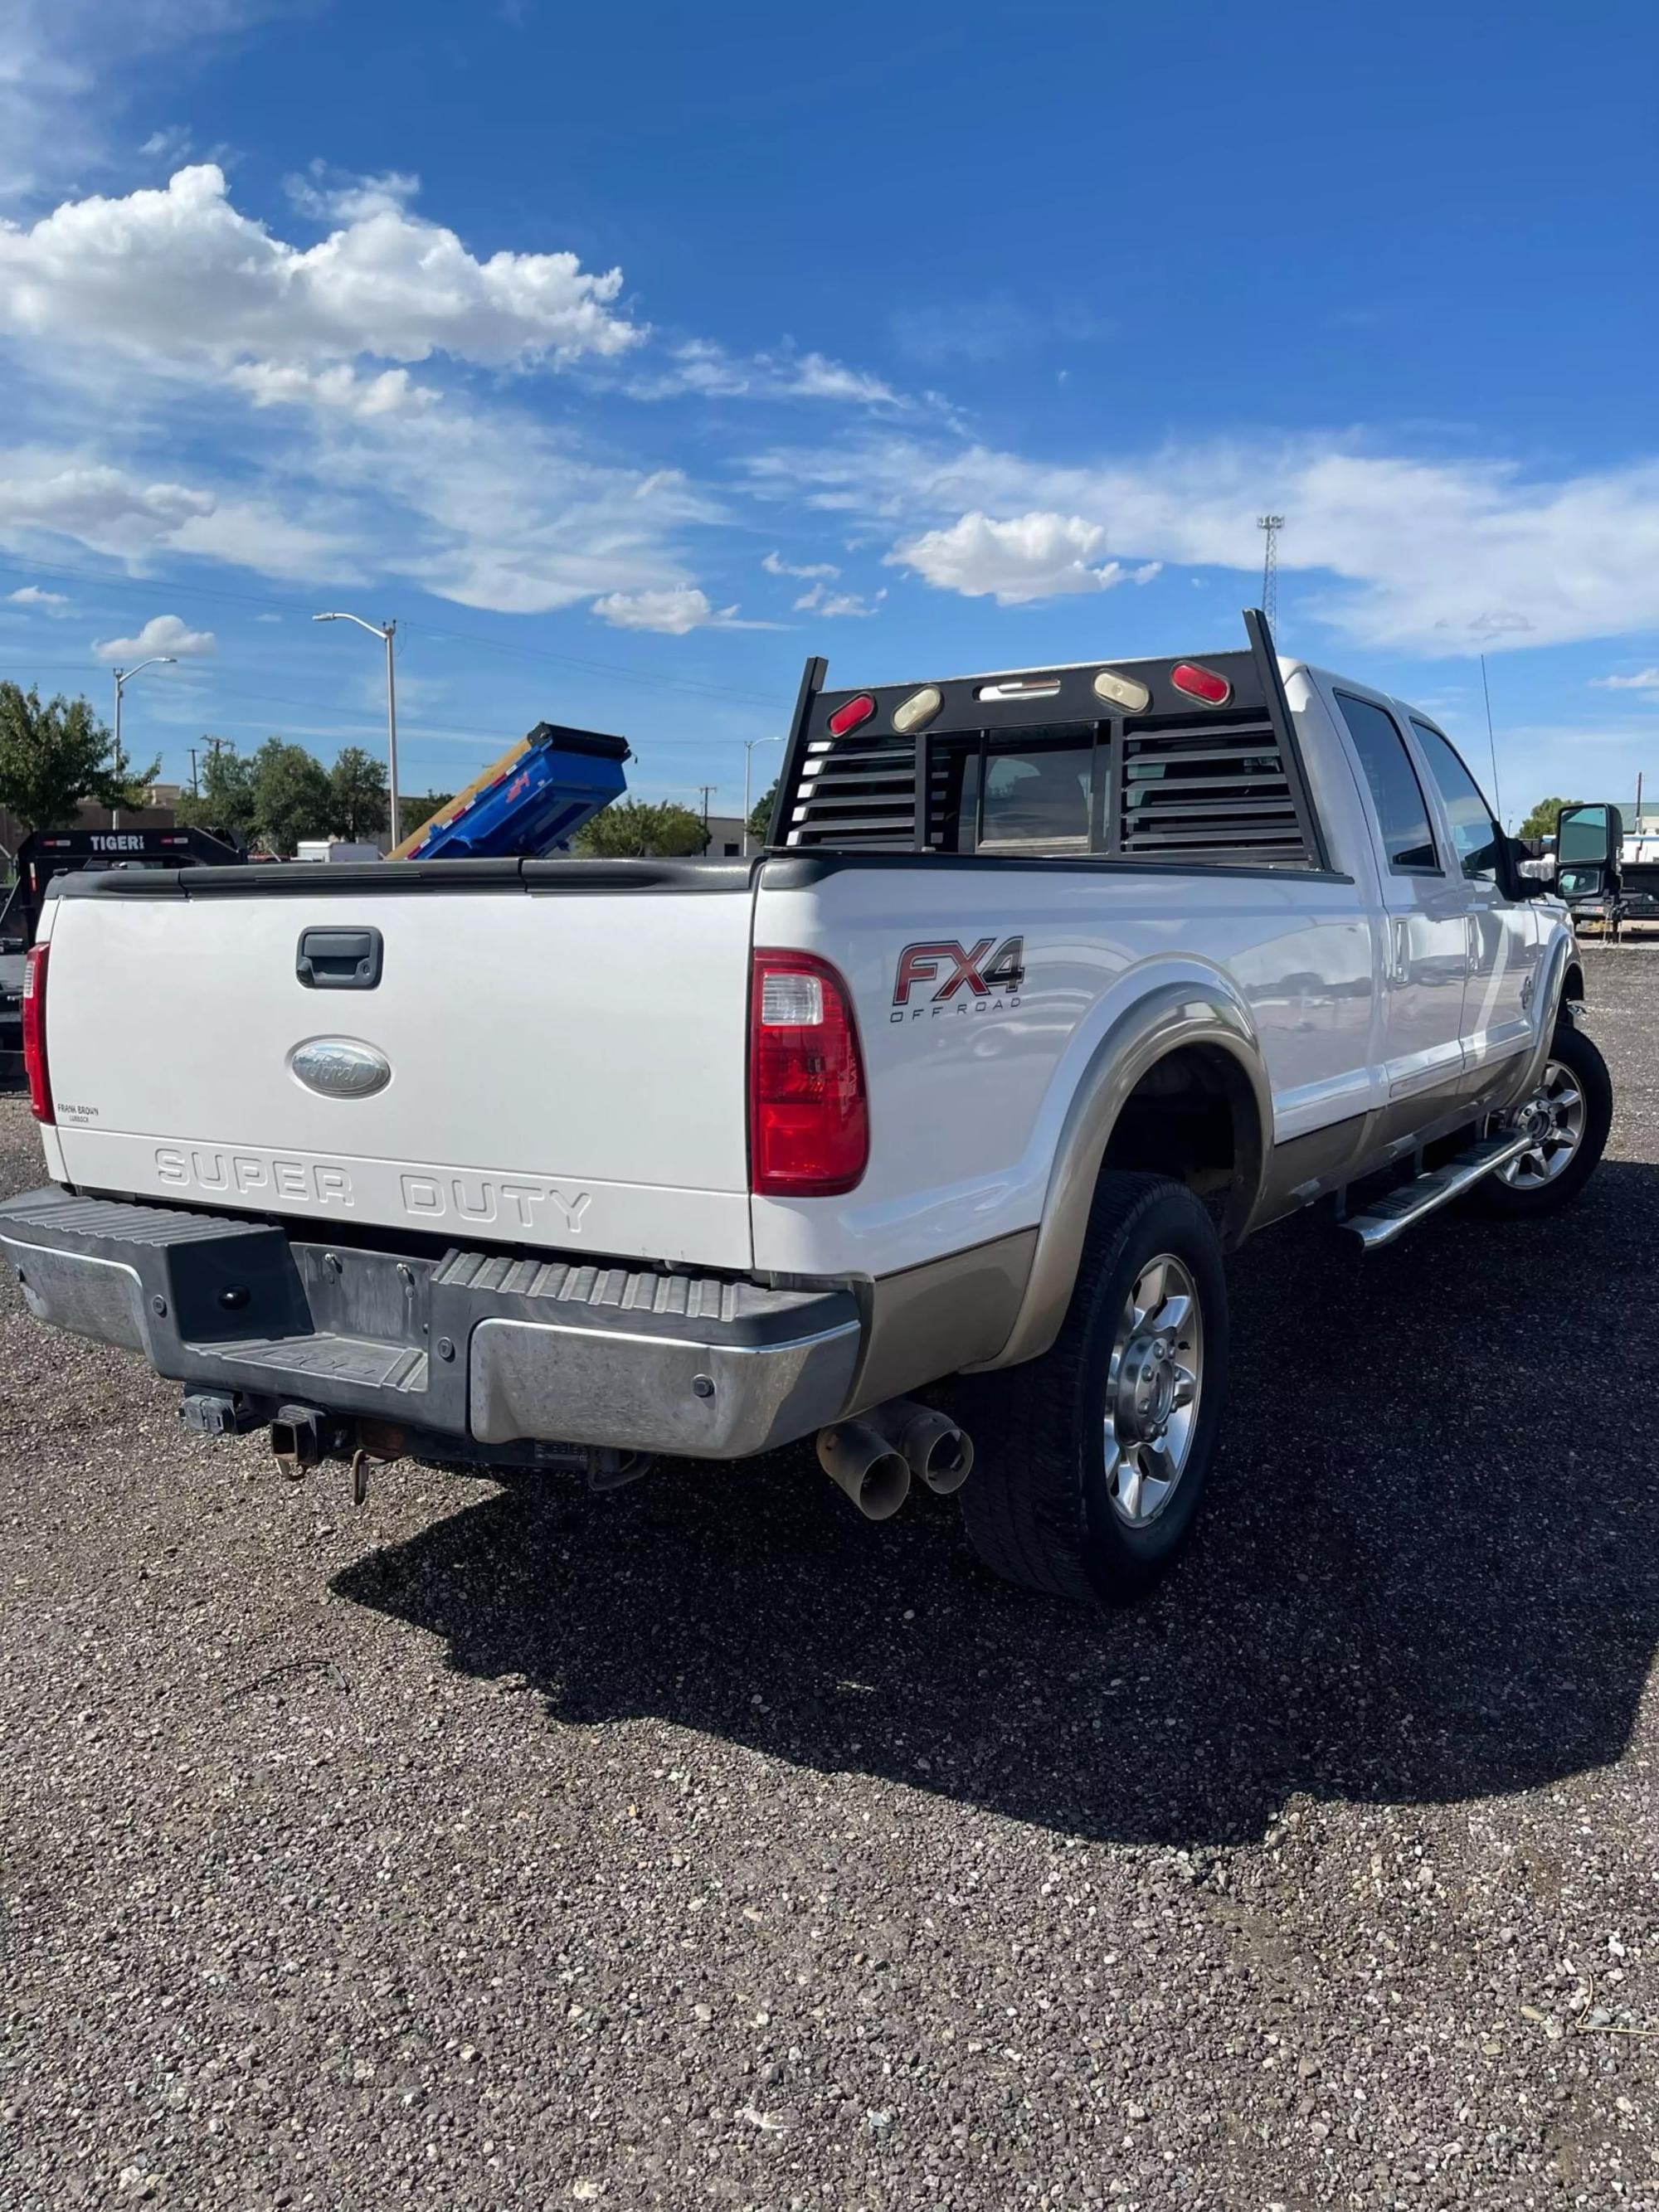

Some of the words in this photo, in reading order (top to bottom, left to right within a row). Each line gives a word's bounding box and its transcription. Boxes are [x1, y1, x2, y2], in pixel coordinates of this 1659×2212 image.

[90, 835, 139, 850] TIGER
[893, 936, 1025, 1006] FX4
[890, 1007, 943, 1023] OFF
[956, 997, 1021, 1015] ROAD
[300, 1052, 359, 1083] Ford
[57, 1103, 77, 1114] FRANK
[77, 1105, 99, 1116] BROWN
[155, 1148, 355, 1207] SUPER
[400, 1174, 591, 1233] DUTY
